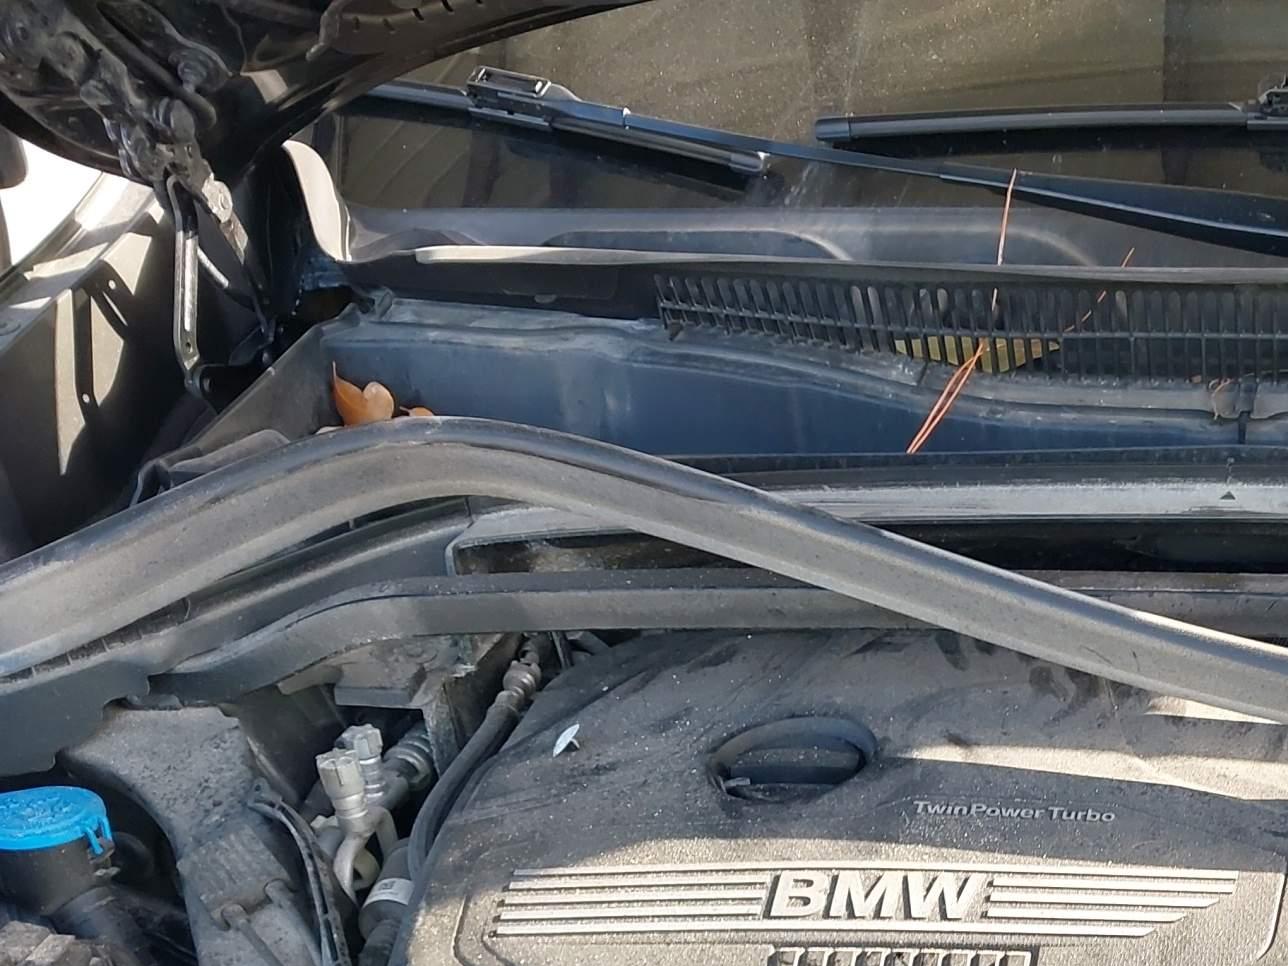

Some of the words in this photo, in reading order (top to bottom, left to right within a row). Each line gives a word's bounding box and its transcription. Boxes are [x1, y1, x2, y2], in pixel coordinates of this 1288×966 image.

[913, 801, 1045, 819] TwinPower
[1048, 806, 1117, 822] Turbo
[769, 870, 987, 920] BMW
